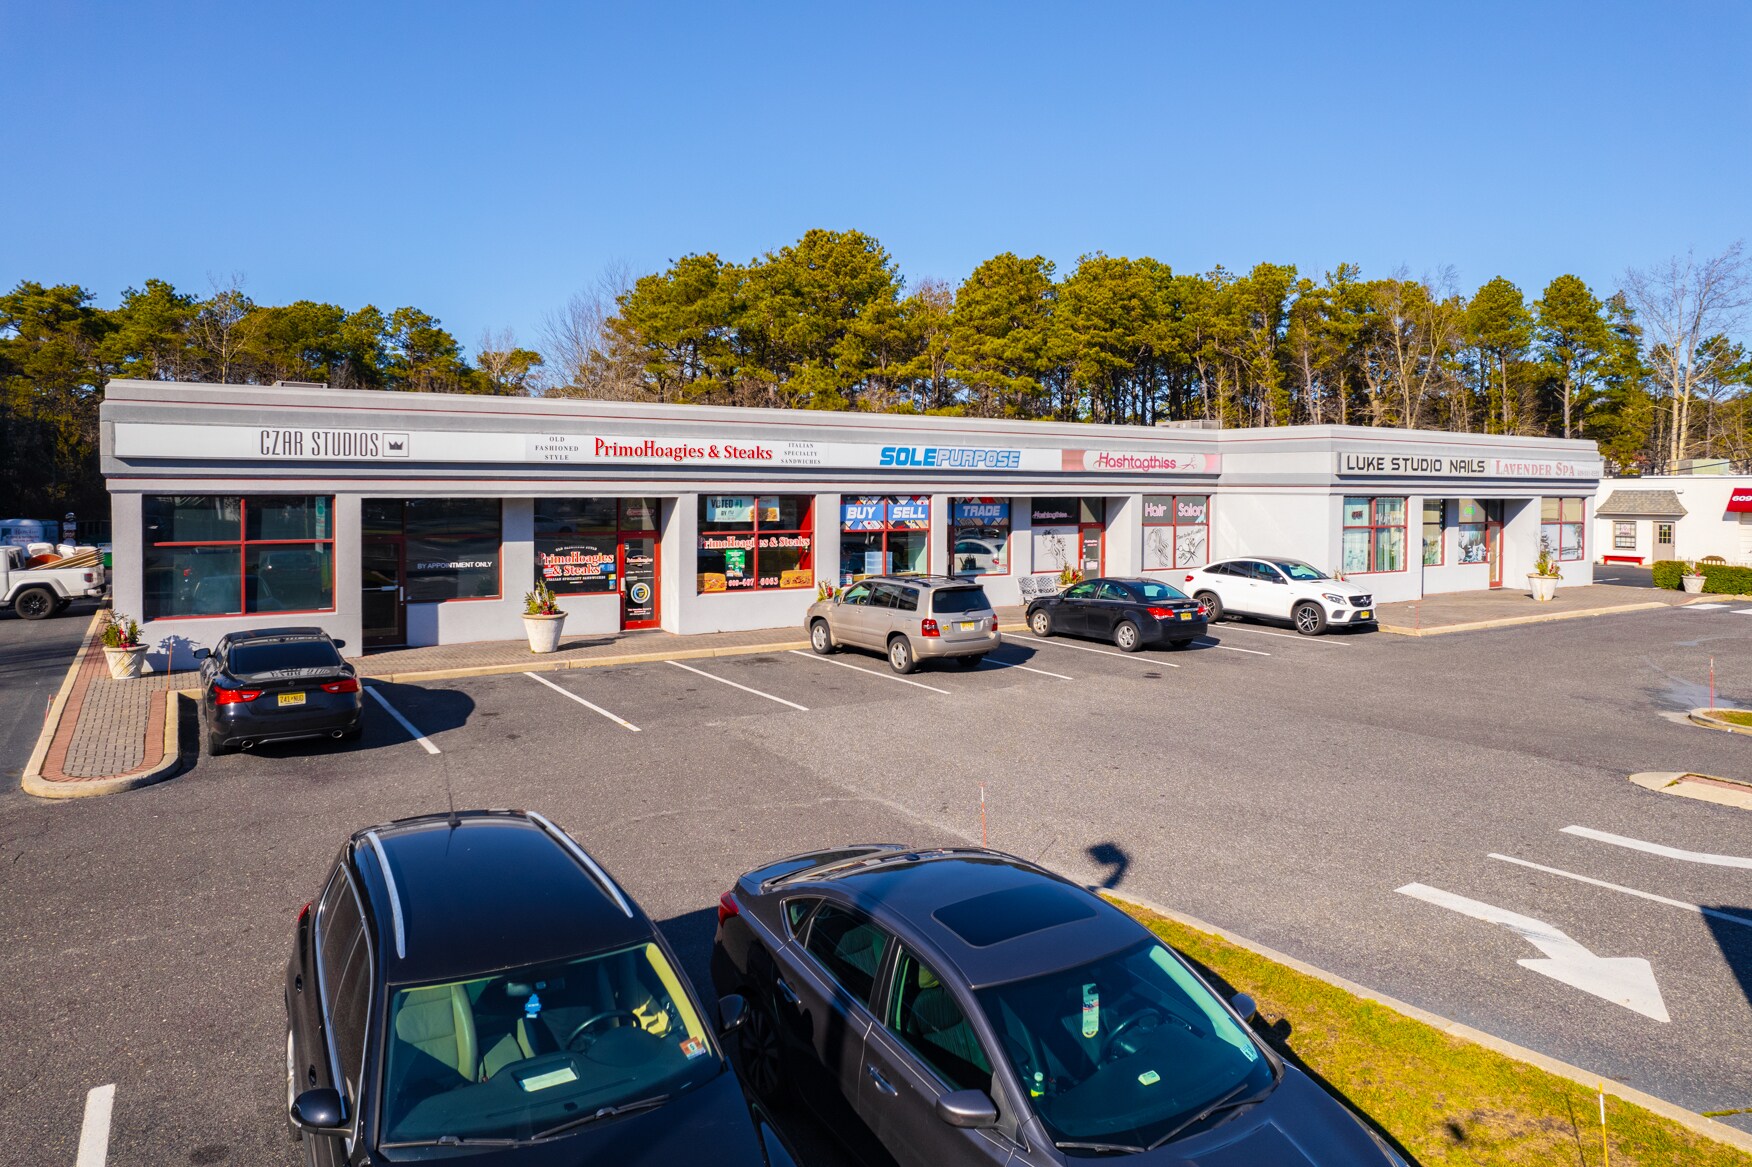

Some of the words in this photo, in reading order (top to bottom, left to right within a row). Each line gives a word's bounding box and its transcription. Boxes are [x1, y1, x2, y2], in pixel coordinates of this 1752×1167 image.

[261, 430, 303, 455] CZAR
[312, 432, 378, 457] STUDIOS
[595, 437, 704, 462] PrimoHoagies
[708, 445, 720, 459] &
[724, 445, 774, 460] Steaks
[1096, 452, 1176, 472] Hashtagthiss
[1347, 455, 1385, 472] LUKE
[1391, 457, 1442, 473] STUDIO
[1450, 459, 1486, 474] NAILS
[711, 499, 734, 508] VOTED
[1145, 503, 1167, 517] Hair
[1178, 503, 1204, 517] Salon
[847, 507, 876, 519] BUY
[893, 507, 926, 519] SELL
[963, 506, 1001, 517] TRADE
[769, 537, 778, 547] &
[779, 535, 811, 548] Steaks
[536, 551, 615, 567] PrimoHoagies
[563, 564, 601, 577] Steaks
